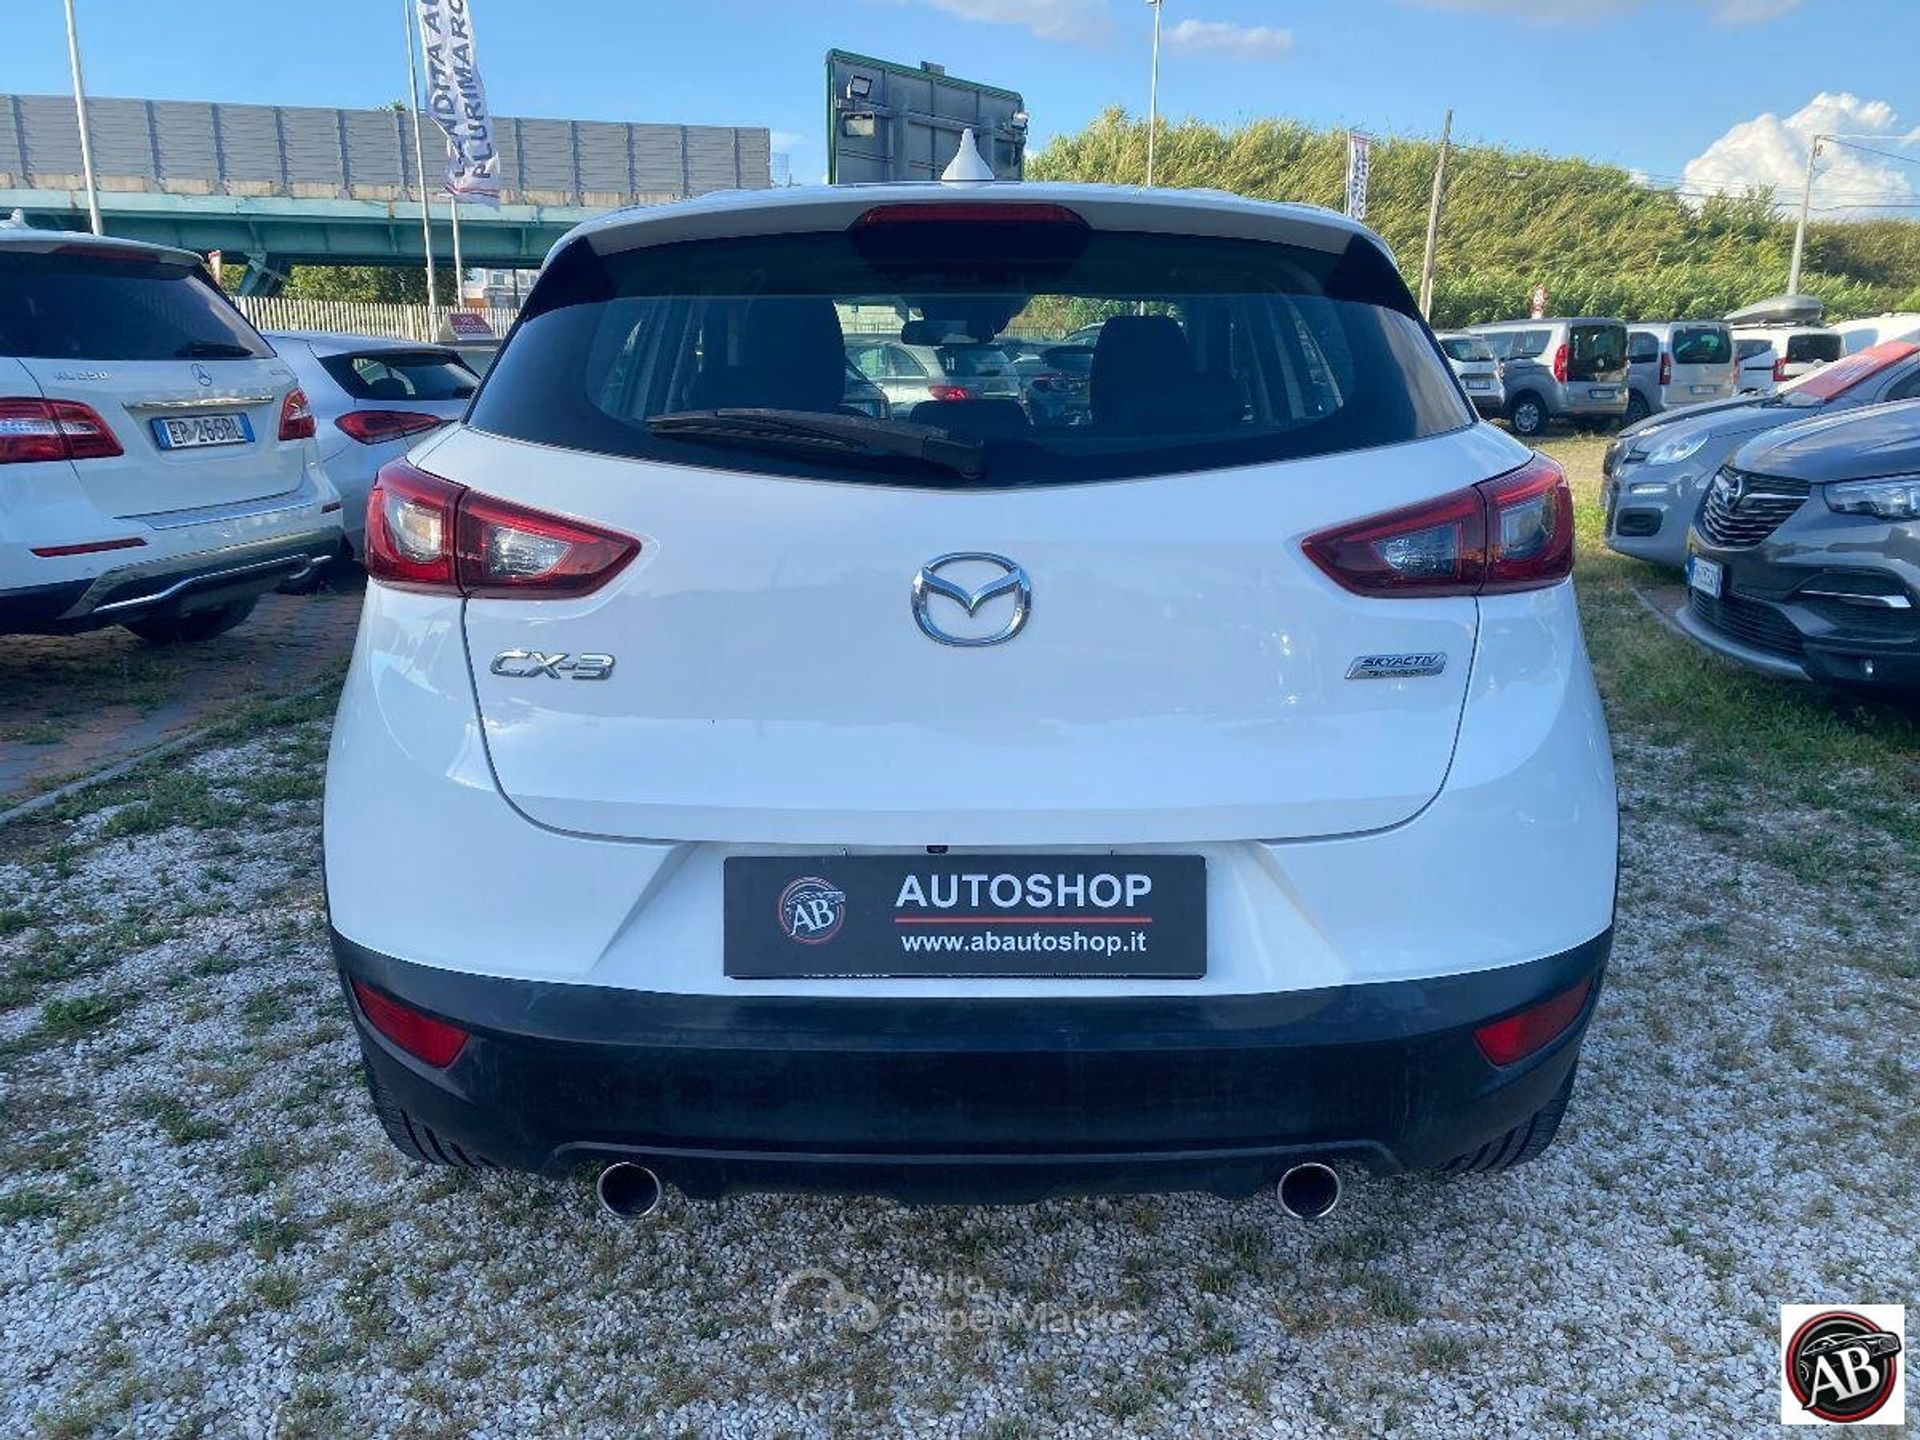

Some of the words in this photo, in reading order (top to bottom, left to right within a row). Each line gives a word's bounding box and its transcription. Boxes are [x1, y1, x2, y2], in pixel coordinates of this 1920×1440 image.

[490, 650, 615, 680] CX-3
[1362, 654, 1439, 667] SKYACTIV
[895, 873, 1152, 908] AUTOSHOP
[788, 898, 835, 937] AB
[901, 931, 1147, 957] www.abautoshop.it
